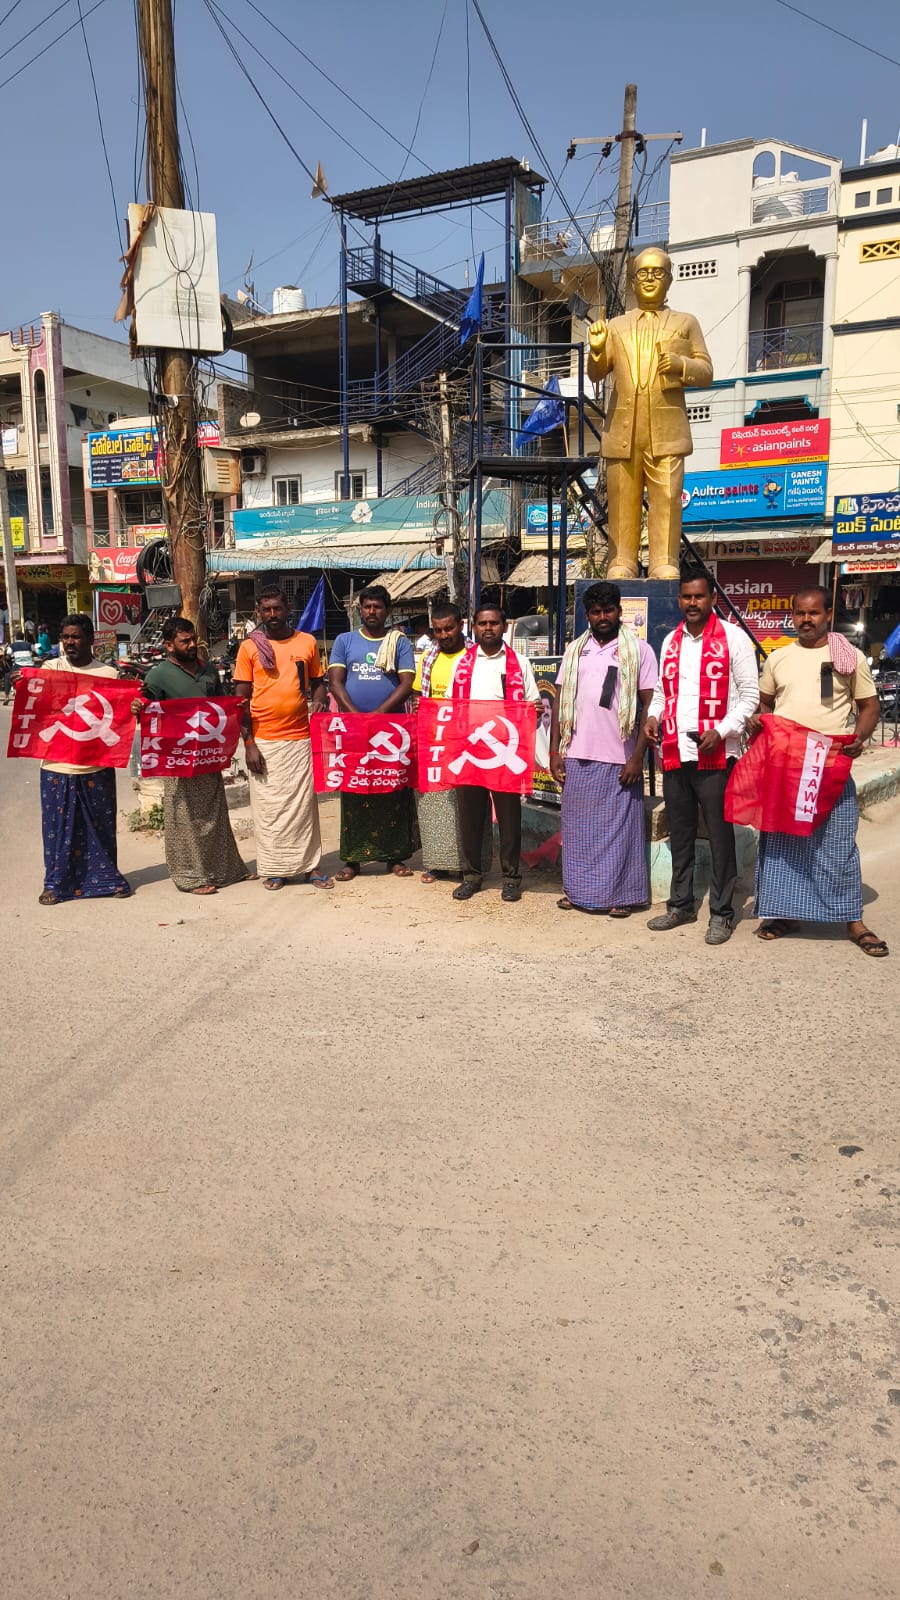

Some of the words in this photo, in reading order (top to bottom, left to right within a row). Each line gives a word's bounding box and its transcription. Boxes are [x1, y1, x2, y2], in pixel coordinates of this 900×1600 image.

[752, 438, 811, 454] asianpaints
[790, 470, 822, 479] GANESH
[792, 477, 820, 486] PAINTS
[692, 483, 759, 497] Aultrapaints
[837, 516, 866, 534] బుక్
[837, 543, 855, 551] కలర్
[724, 579, 773, 595] asian
[12, 678, 45, 749] CITU
[141, 701, 165, 769] AIKS
[326, 717, 347, 787] AIKS
[427, 706, 453, 782] CITU
